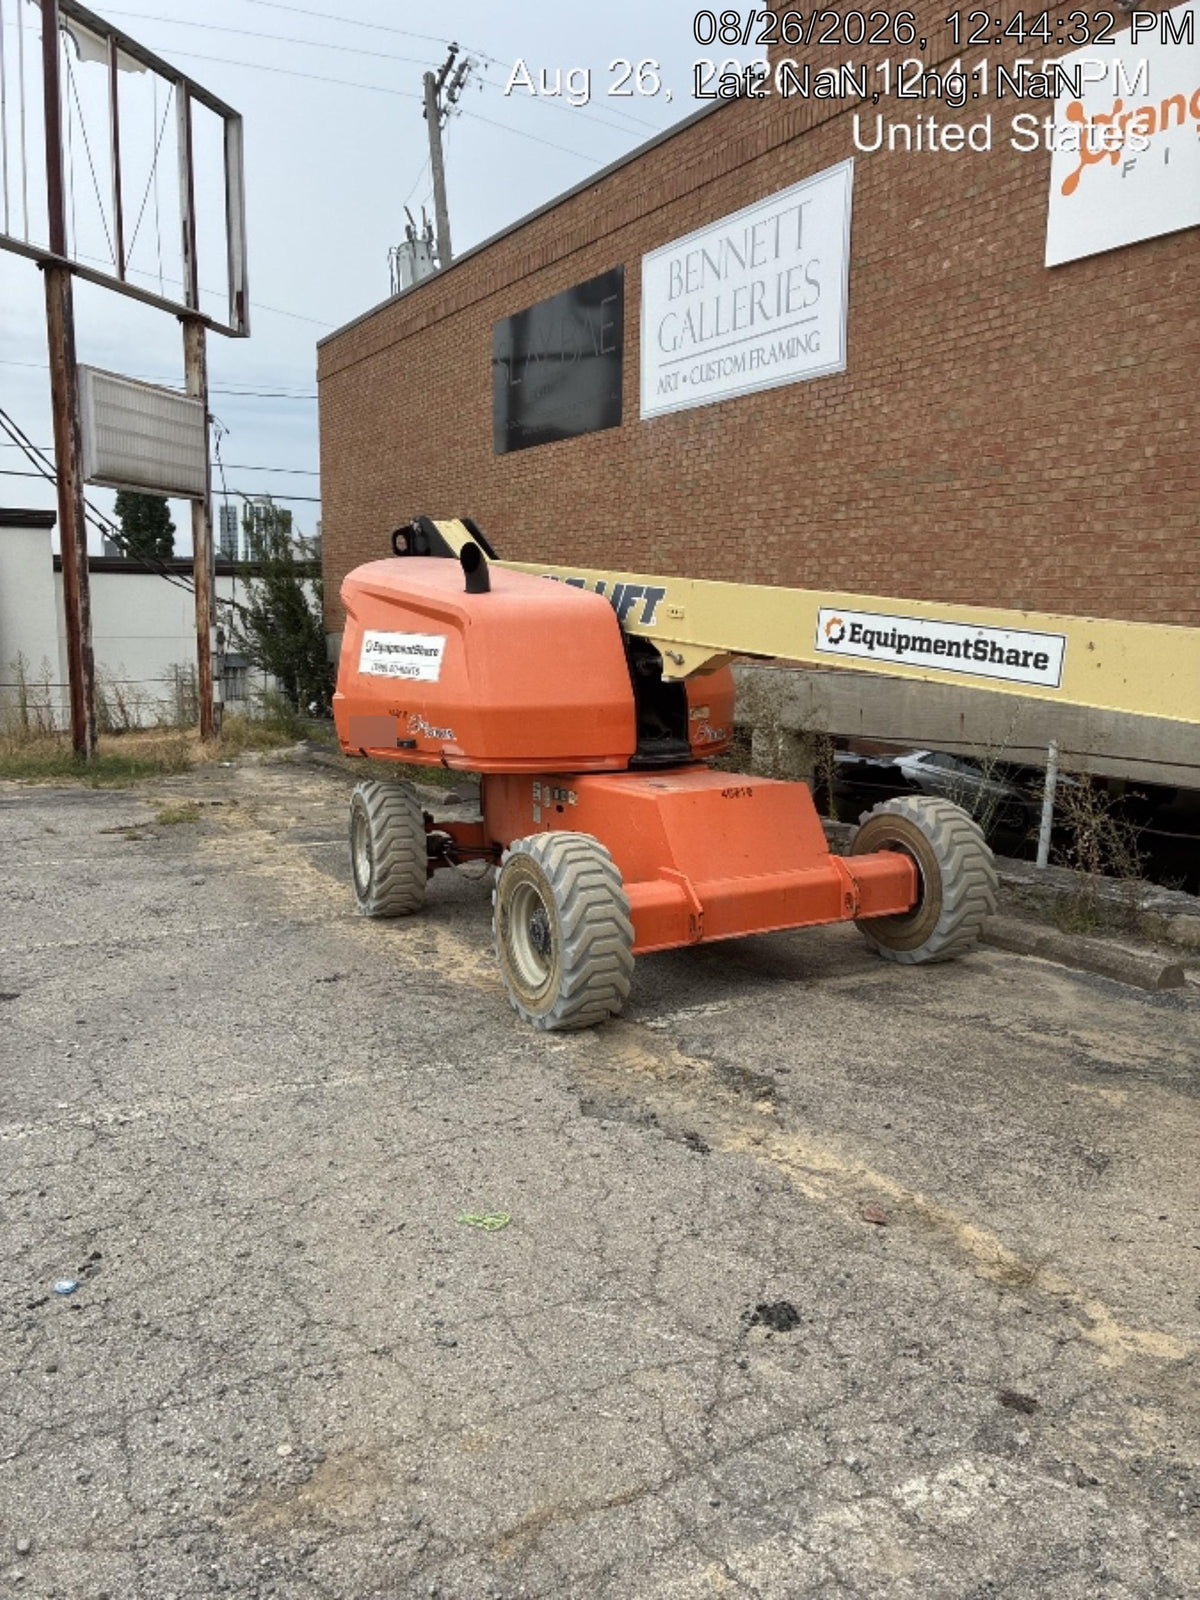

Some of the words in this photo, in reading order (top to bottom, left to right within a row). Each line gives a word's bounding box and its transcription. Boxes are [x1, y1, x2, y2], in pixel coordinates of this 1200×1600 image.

[667, 199, 813, 302] BENNETT
[657, 258, 821, 353] GALLERIES
[656, 371, 681, 395] ART
[689, 351, 747, 385] CUSTOM
[749, 329, 821, 371] FRAMING
[847, 622, 1050, 671] EquipmentShare
